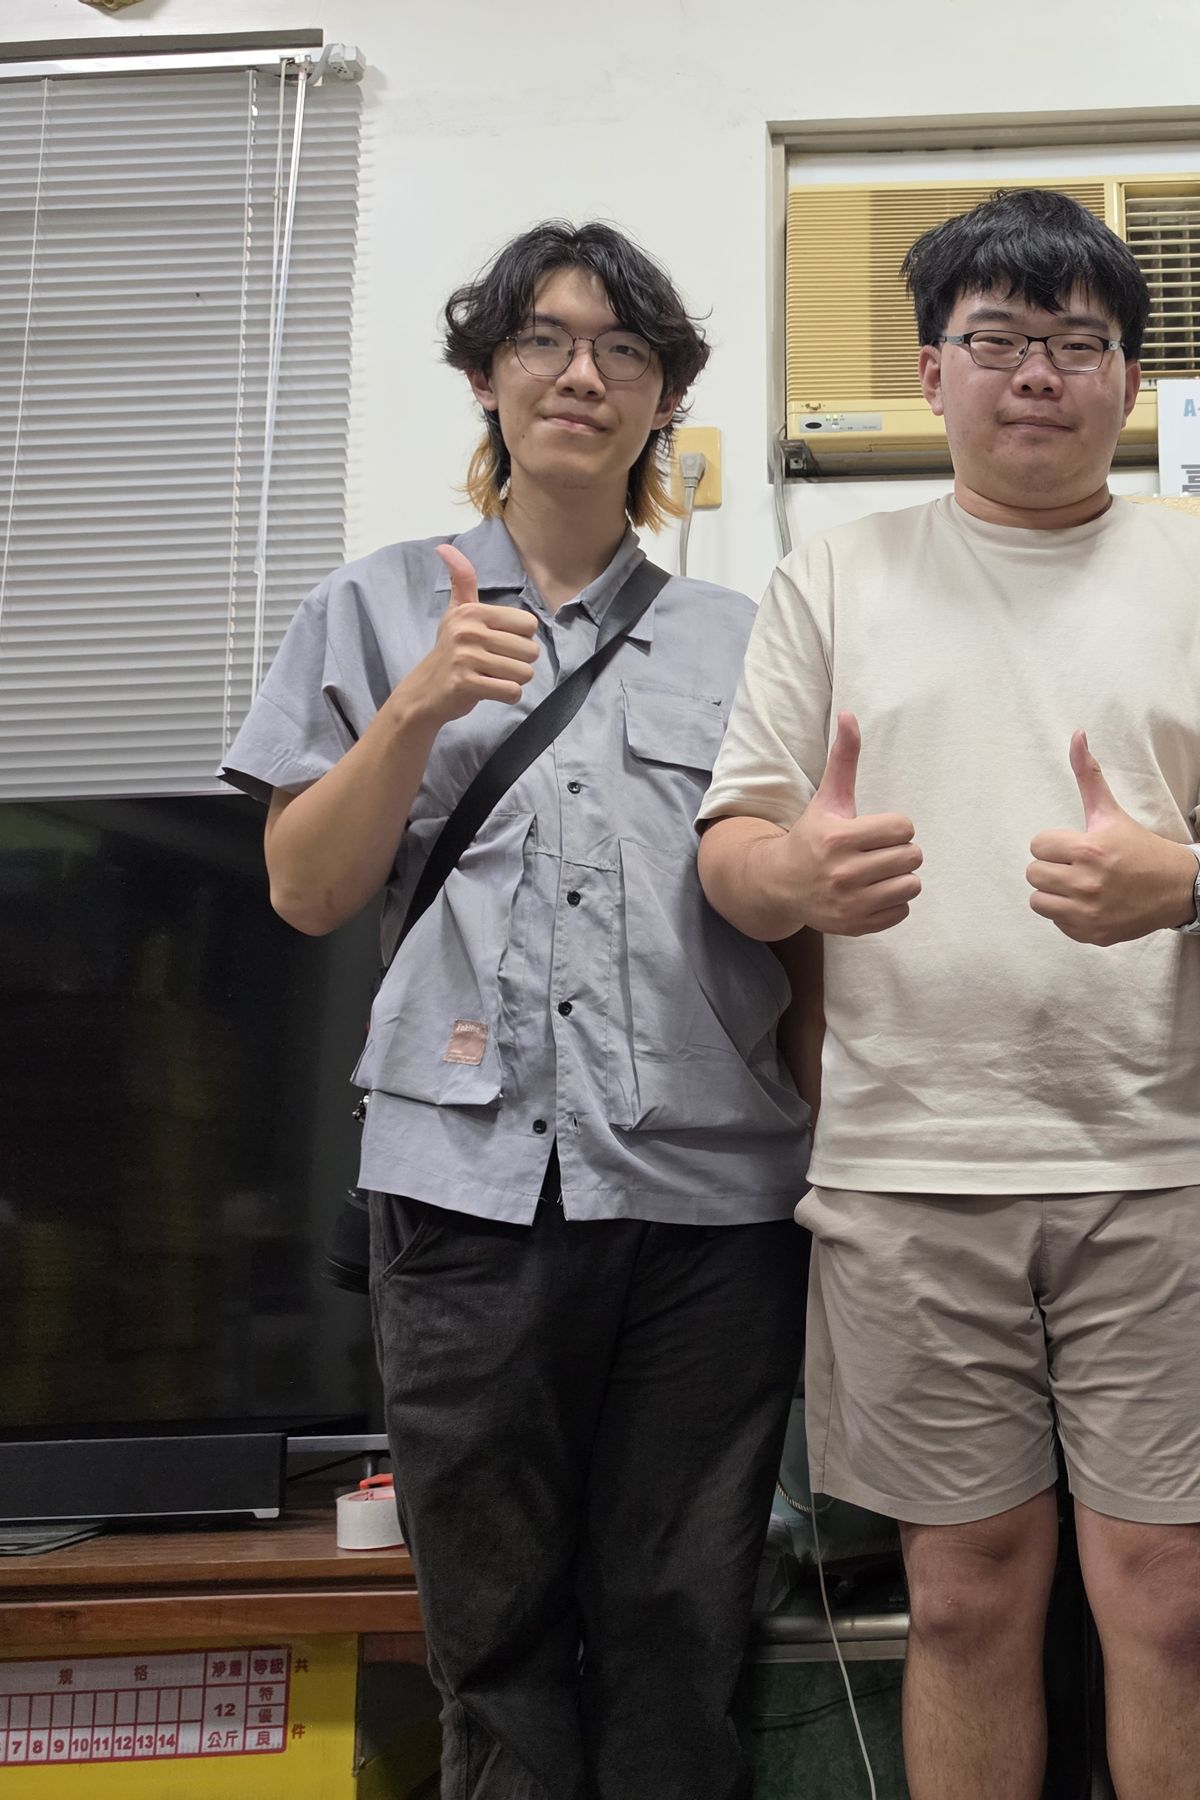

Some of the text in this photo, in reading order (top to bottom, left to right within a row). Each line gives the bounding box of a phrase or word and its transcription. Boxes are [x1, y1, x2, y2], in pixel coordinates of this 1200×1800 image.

[212, 1660, 242, 1678] 淨重
[254, 1658, 284, 1675] 等級
[294, 1657, 309, 1674] 共
[213, 1703, 236, 1718] 12
[207, 1730, 271, 1749] 公斤 良
[292, 1723, 306, 1740] 件
[12, 1734, 176, 1754] 7 8 9 10 11 12 13 14
